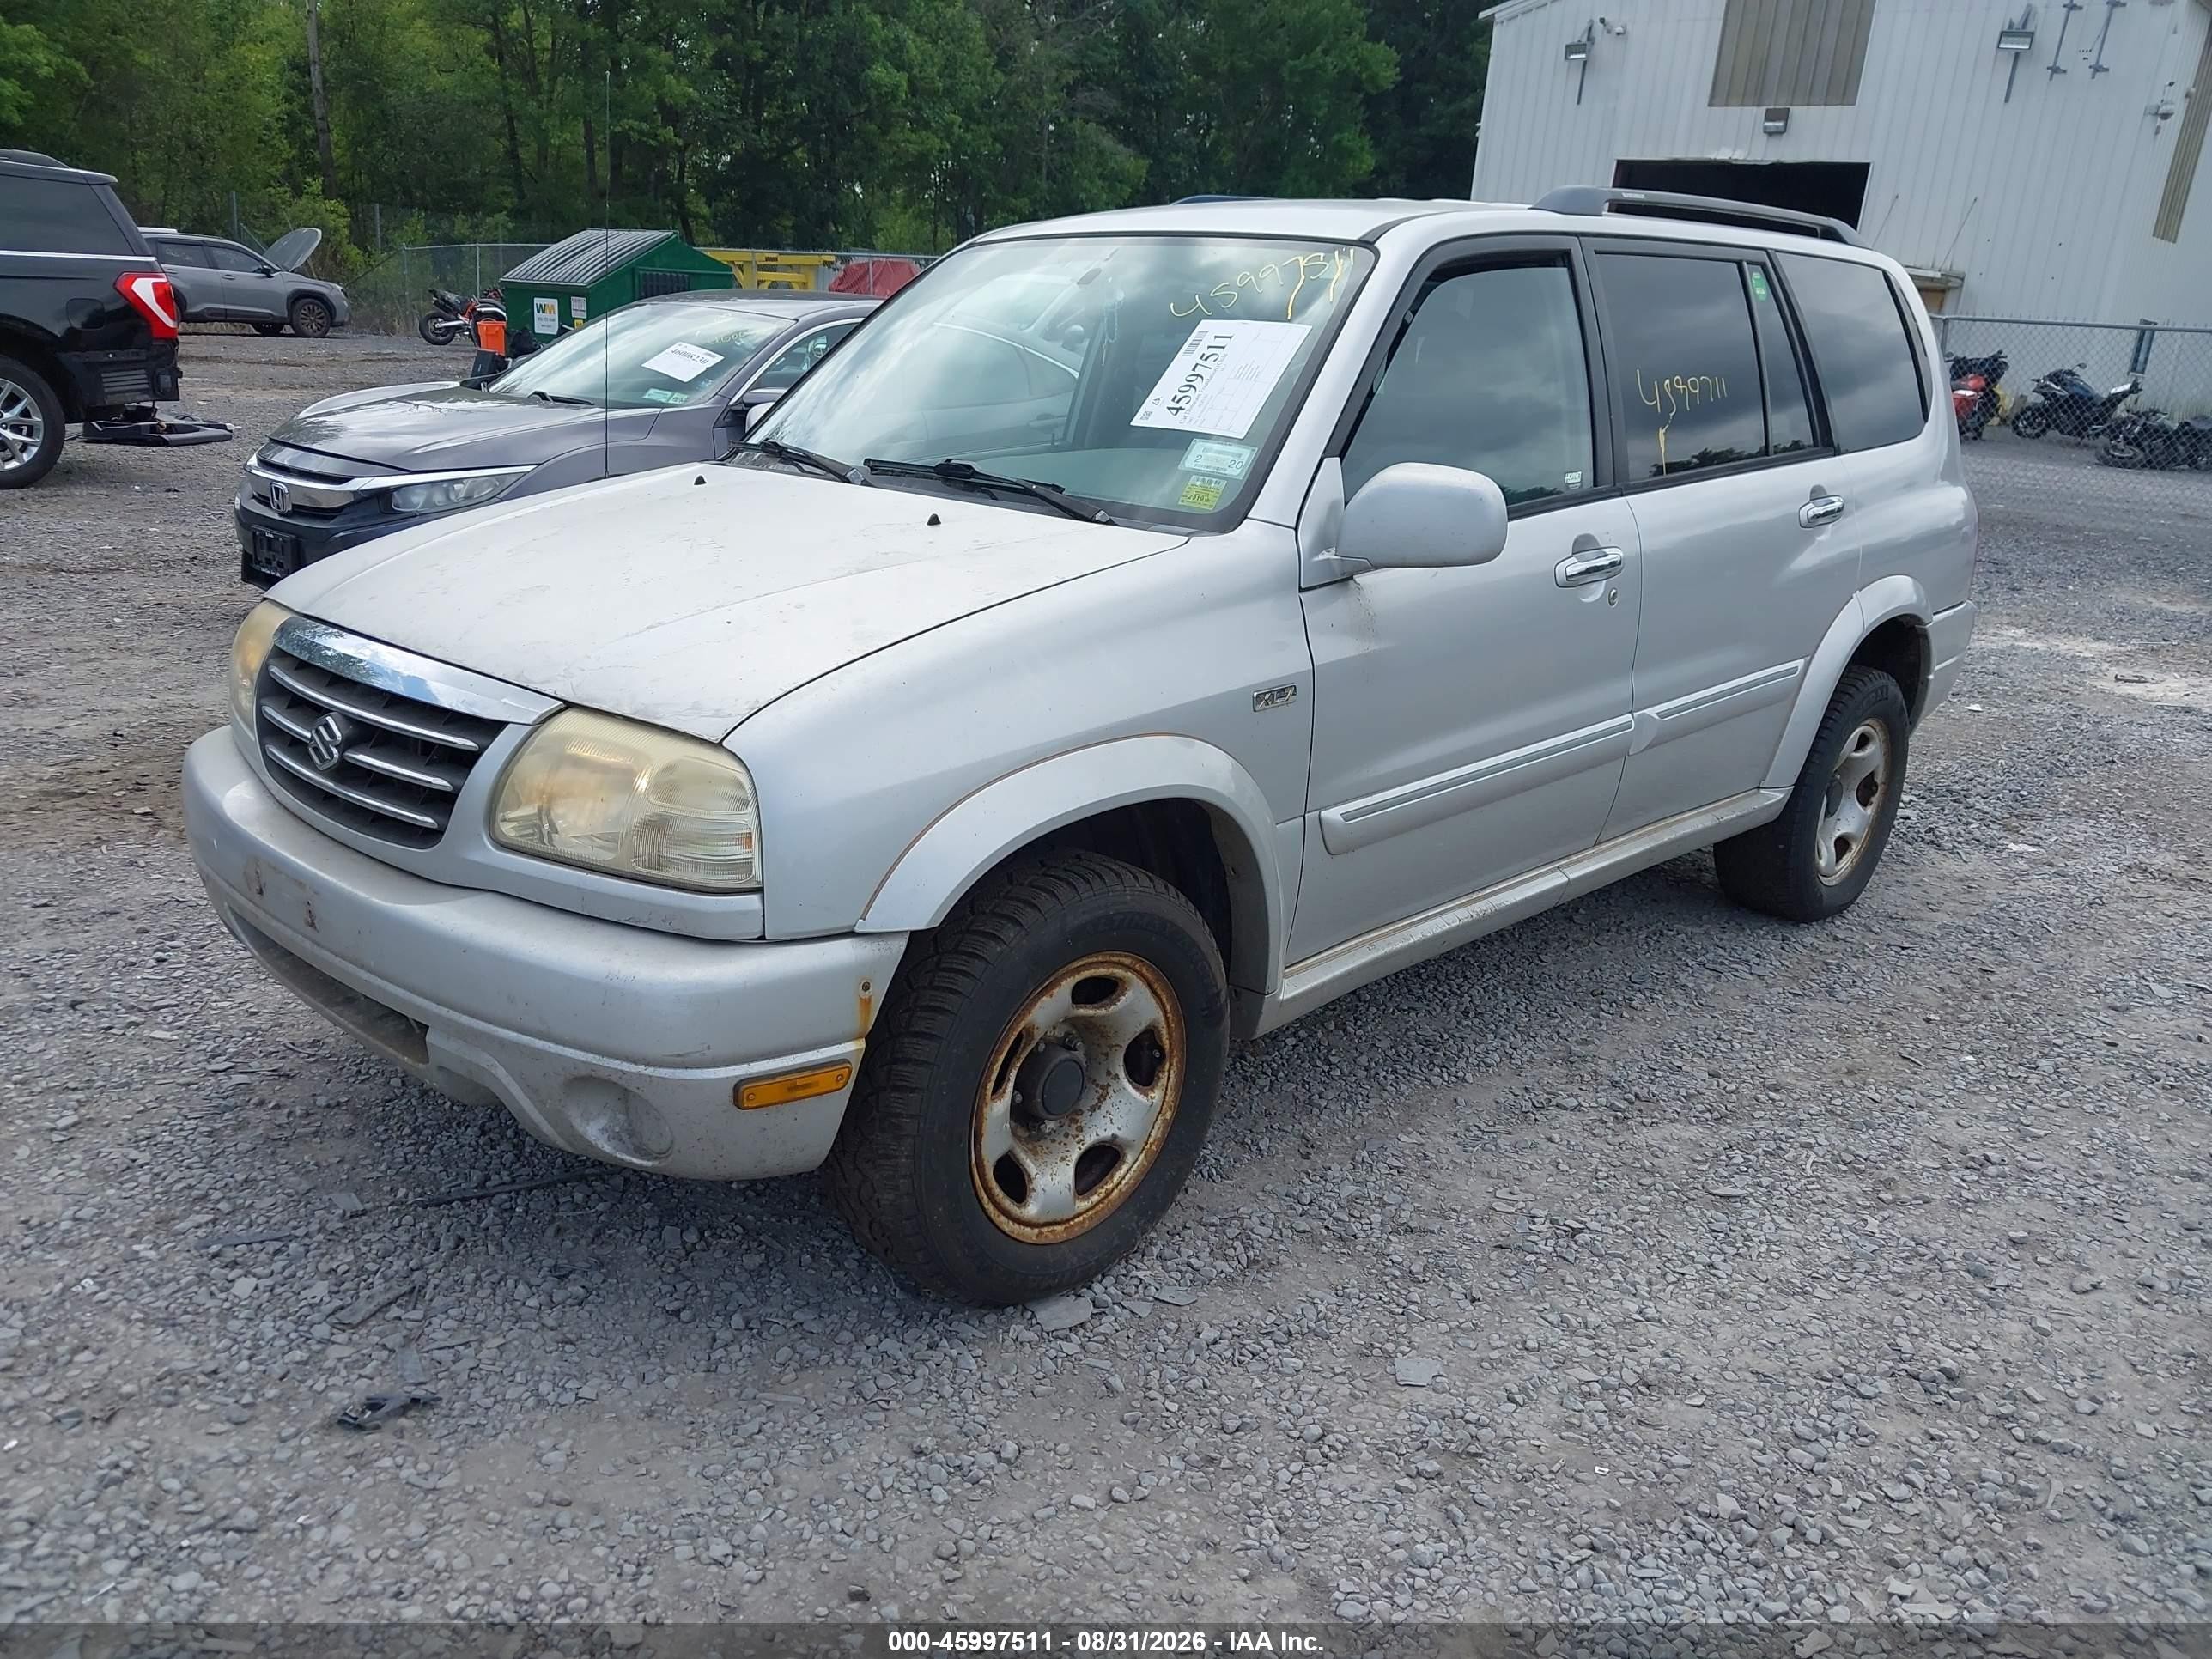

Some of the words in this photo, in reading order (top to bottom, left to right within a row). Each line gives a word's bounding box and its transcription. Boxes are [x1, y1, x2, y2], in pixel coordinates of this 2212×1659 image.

[536, 303, 556, 314] WM
[1166, 334, 1235, 416] 45997511
[1228, 459, 1243, 470] 20
